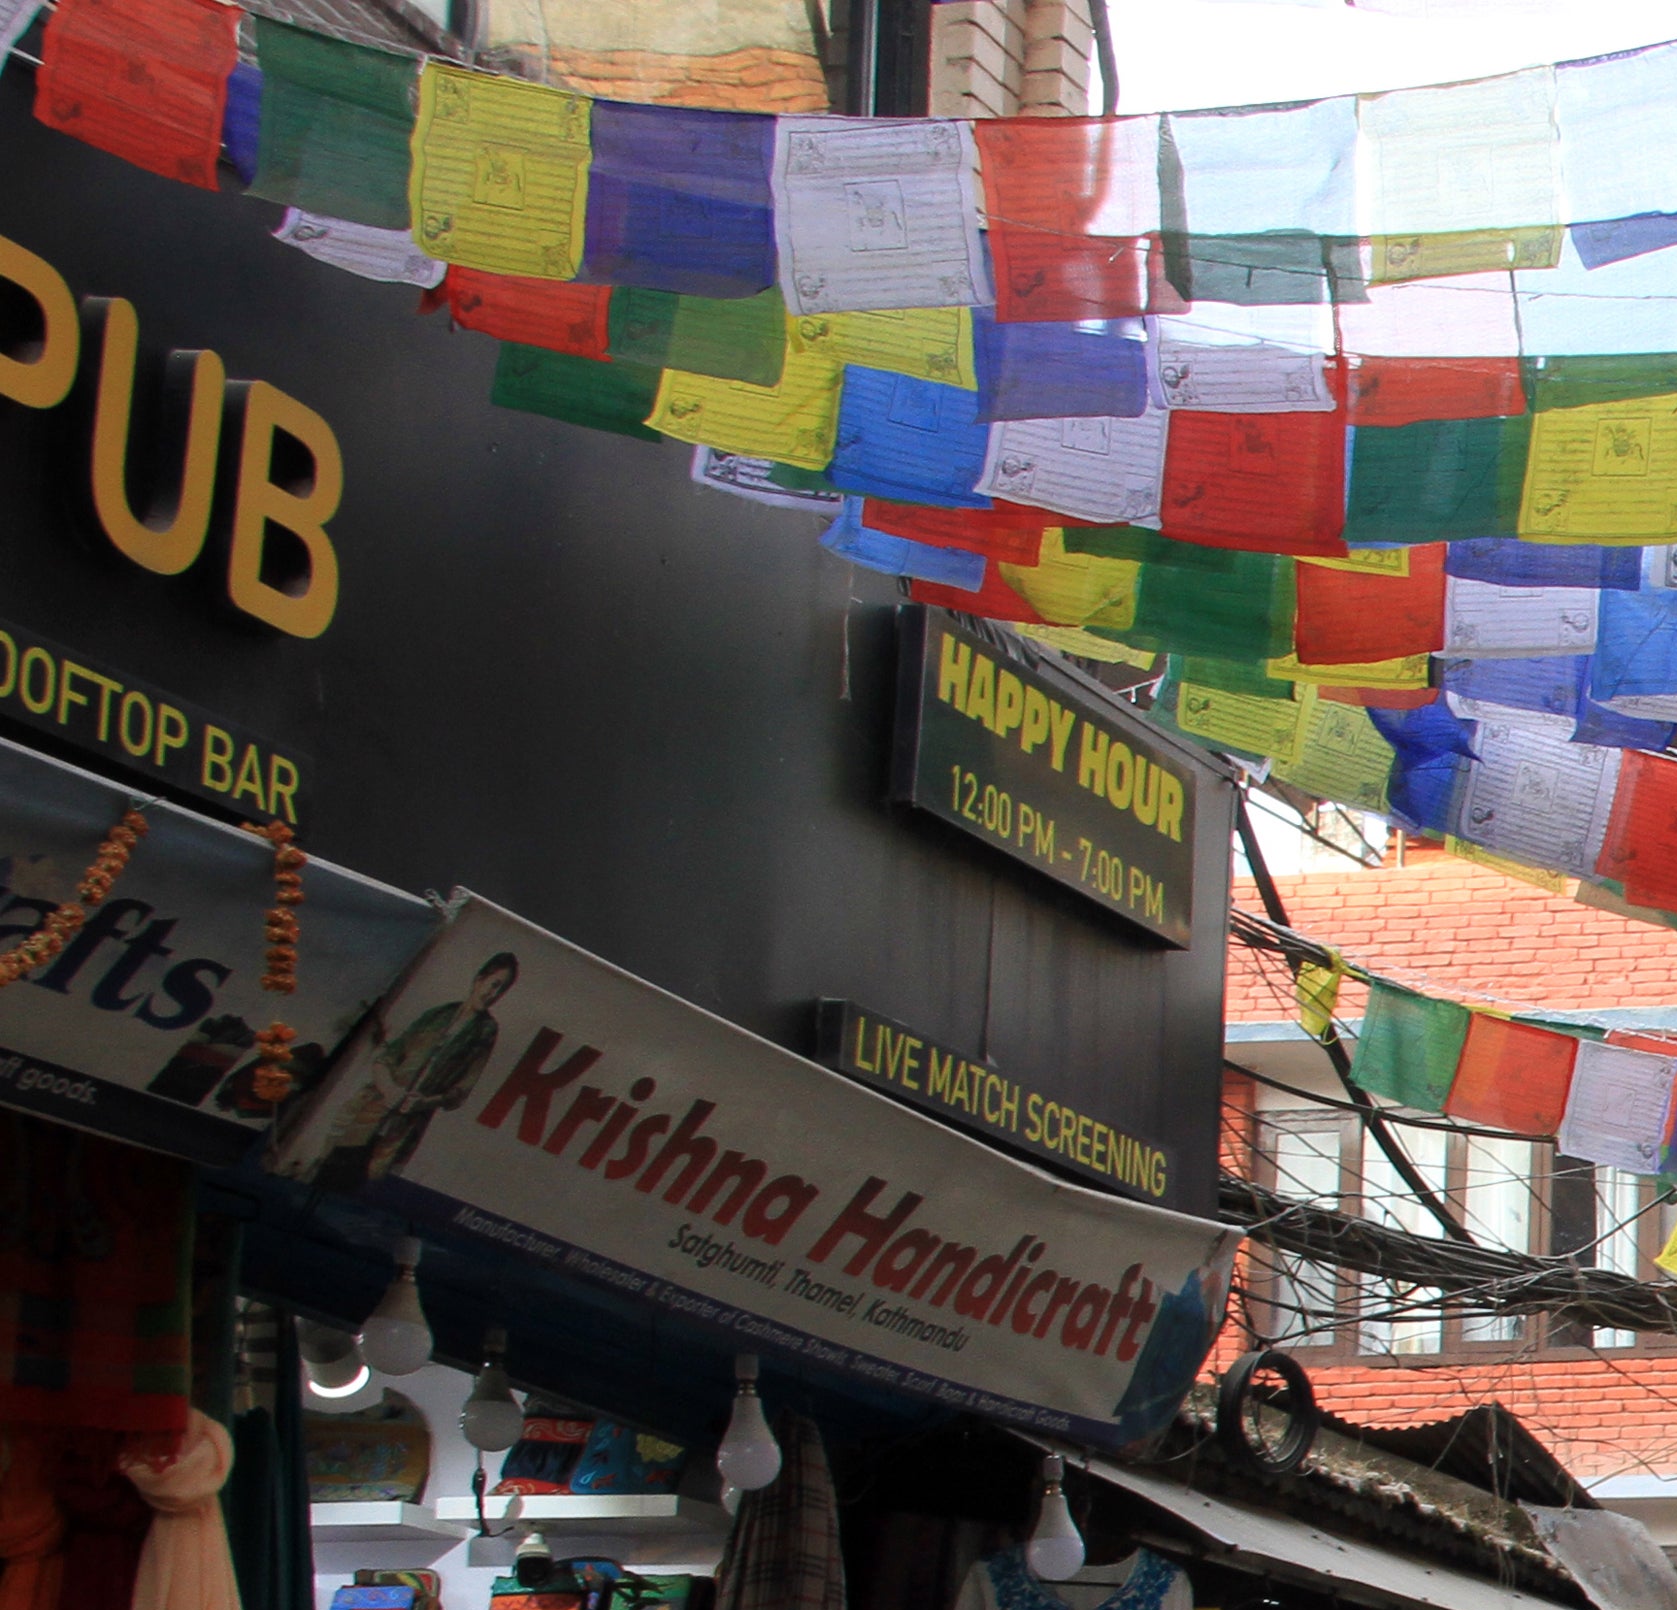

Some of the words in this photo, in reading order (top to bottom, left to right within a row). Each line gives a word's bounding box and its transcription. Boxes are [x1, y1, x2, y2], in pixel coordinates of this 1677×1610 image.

[202, 724, 299, 824] BAR
[939, 632, 1076, 773] HAPPY
[1078, 719, 1186, 843] HOUR
[951, 764, 1012, 840] 12:00
[1017, 802, 1055, 864] PM
[1079, 837, 1123, 902] 7:00
[1130, 865, 1165, 925] PM
[854, 1015, 919, 1089] LIVE
[927, 1047, 1020, 1135] MATCH
[1027, 1091, 1168, 1198] SCREENING
[477, 1026, 822, 1245] Krishna
[808, 1176, 1158, 1363] Handicraft
[668, 1222, 786, 1291] Satghumti,
[785, 1268, 865, 1319] Thamel,
[862, 1298, 970, 1352] Kathmandu
